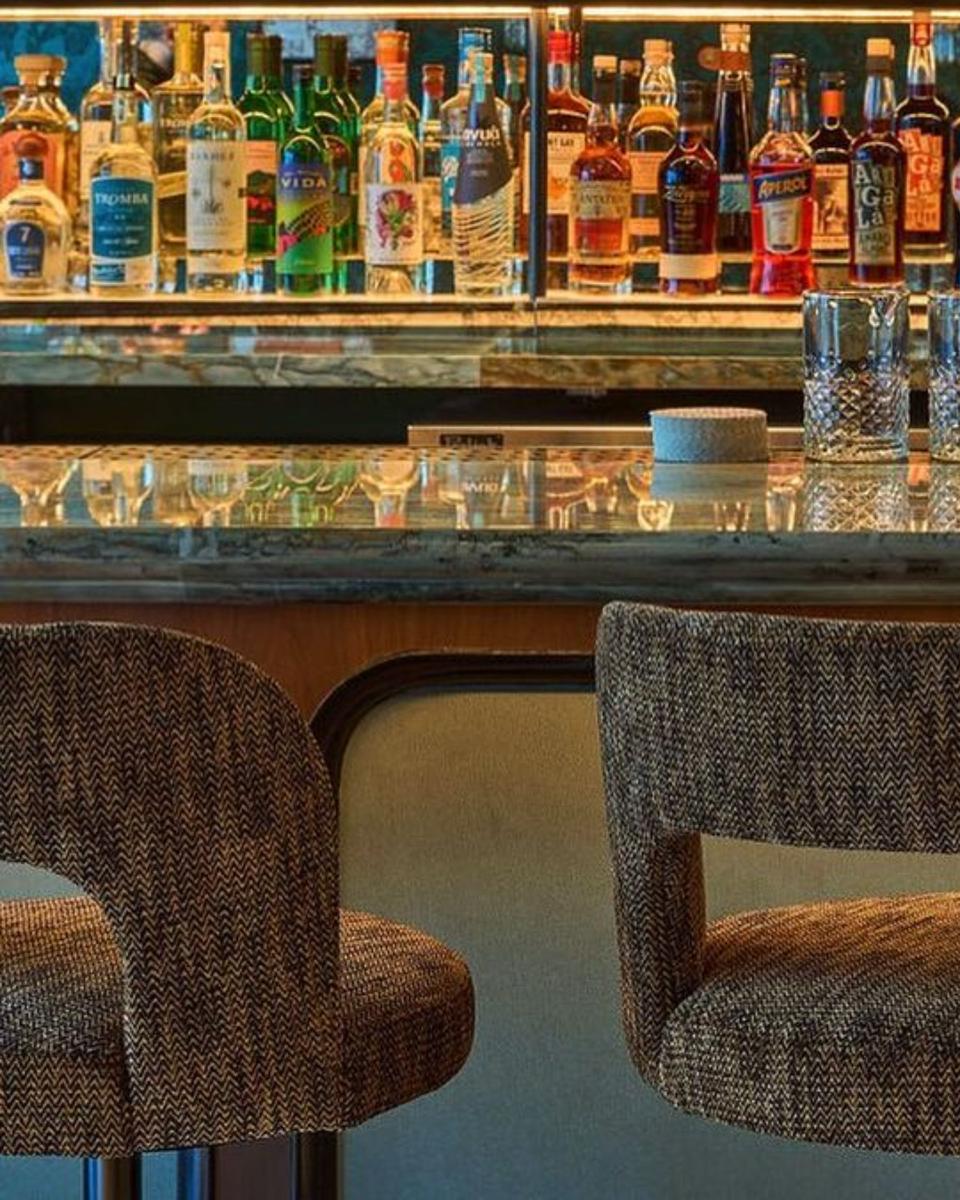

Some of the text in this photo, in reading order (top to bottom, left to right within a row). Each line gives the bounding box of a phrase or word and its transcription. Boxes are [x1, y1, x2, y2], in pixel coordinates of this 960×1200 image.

[280, 178, 328, 189] VIDA
[758, 177, 807, 200] APEROL
[94, 192, 151, 206] TROMBA
[20, 226, 32, 243] 7
